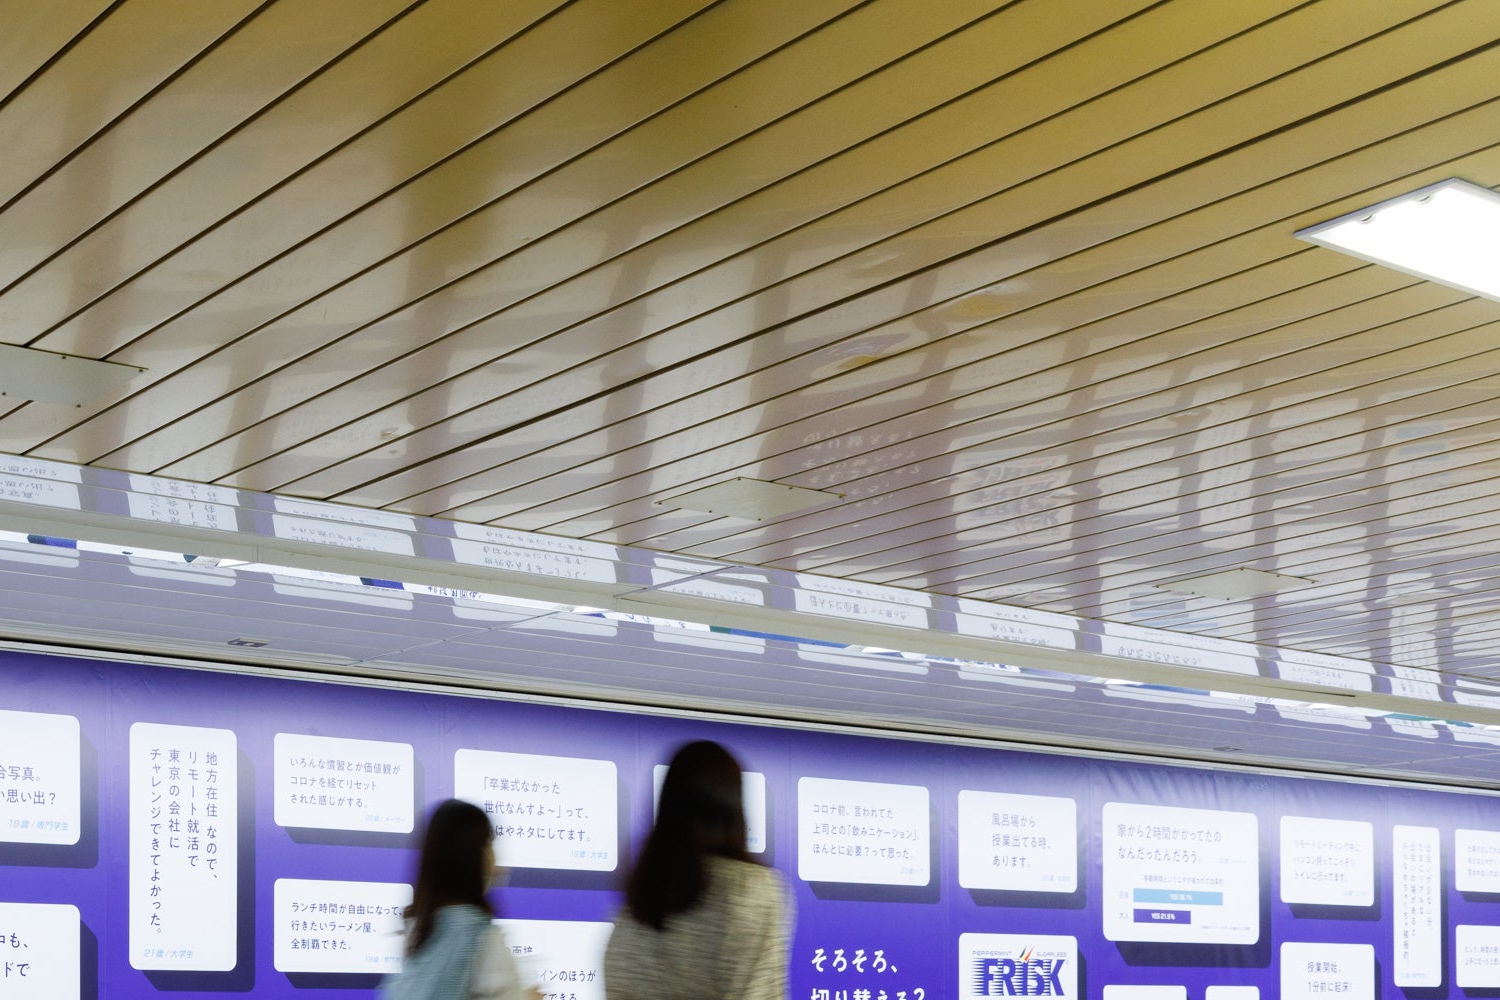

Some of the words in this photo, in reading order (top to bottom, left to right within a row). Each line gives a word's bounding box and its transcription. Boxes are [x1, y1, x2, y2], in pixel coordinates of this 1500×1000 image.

[167, 747, 181, 850] 東京の会社に
[186, 749, 200, 868] リモート就活で
[491, 825, 592, 843] はやネタにしてます。
[150, 747, 163, 935] チャレンジできてよかった。
[811, 948, 898, 973] そろそろ、
[971, 957, 1066, 996] FRISK
